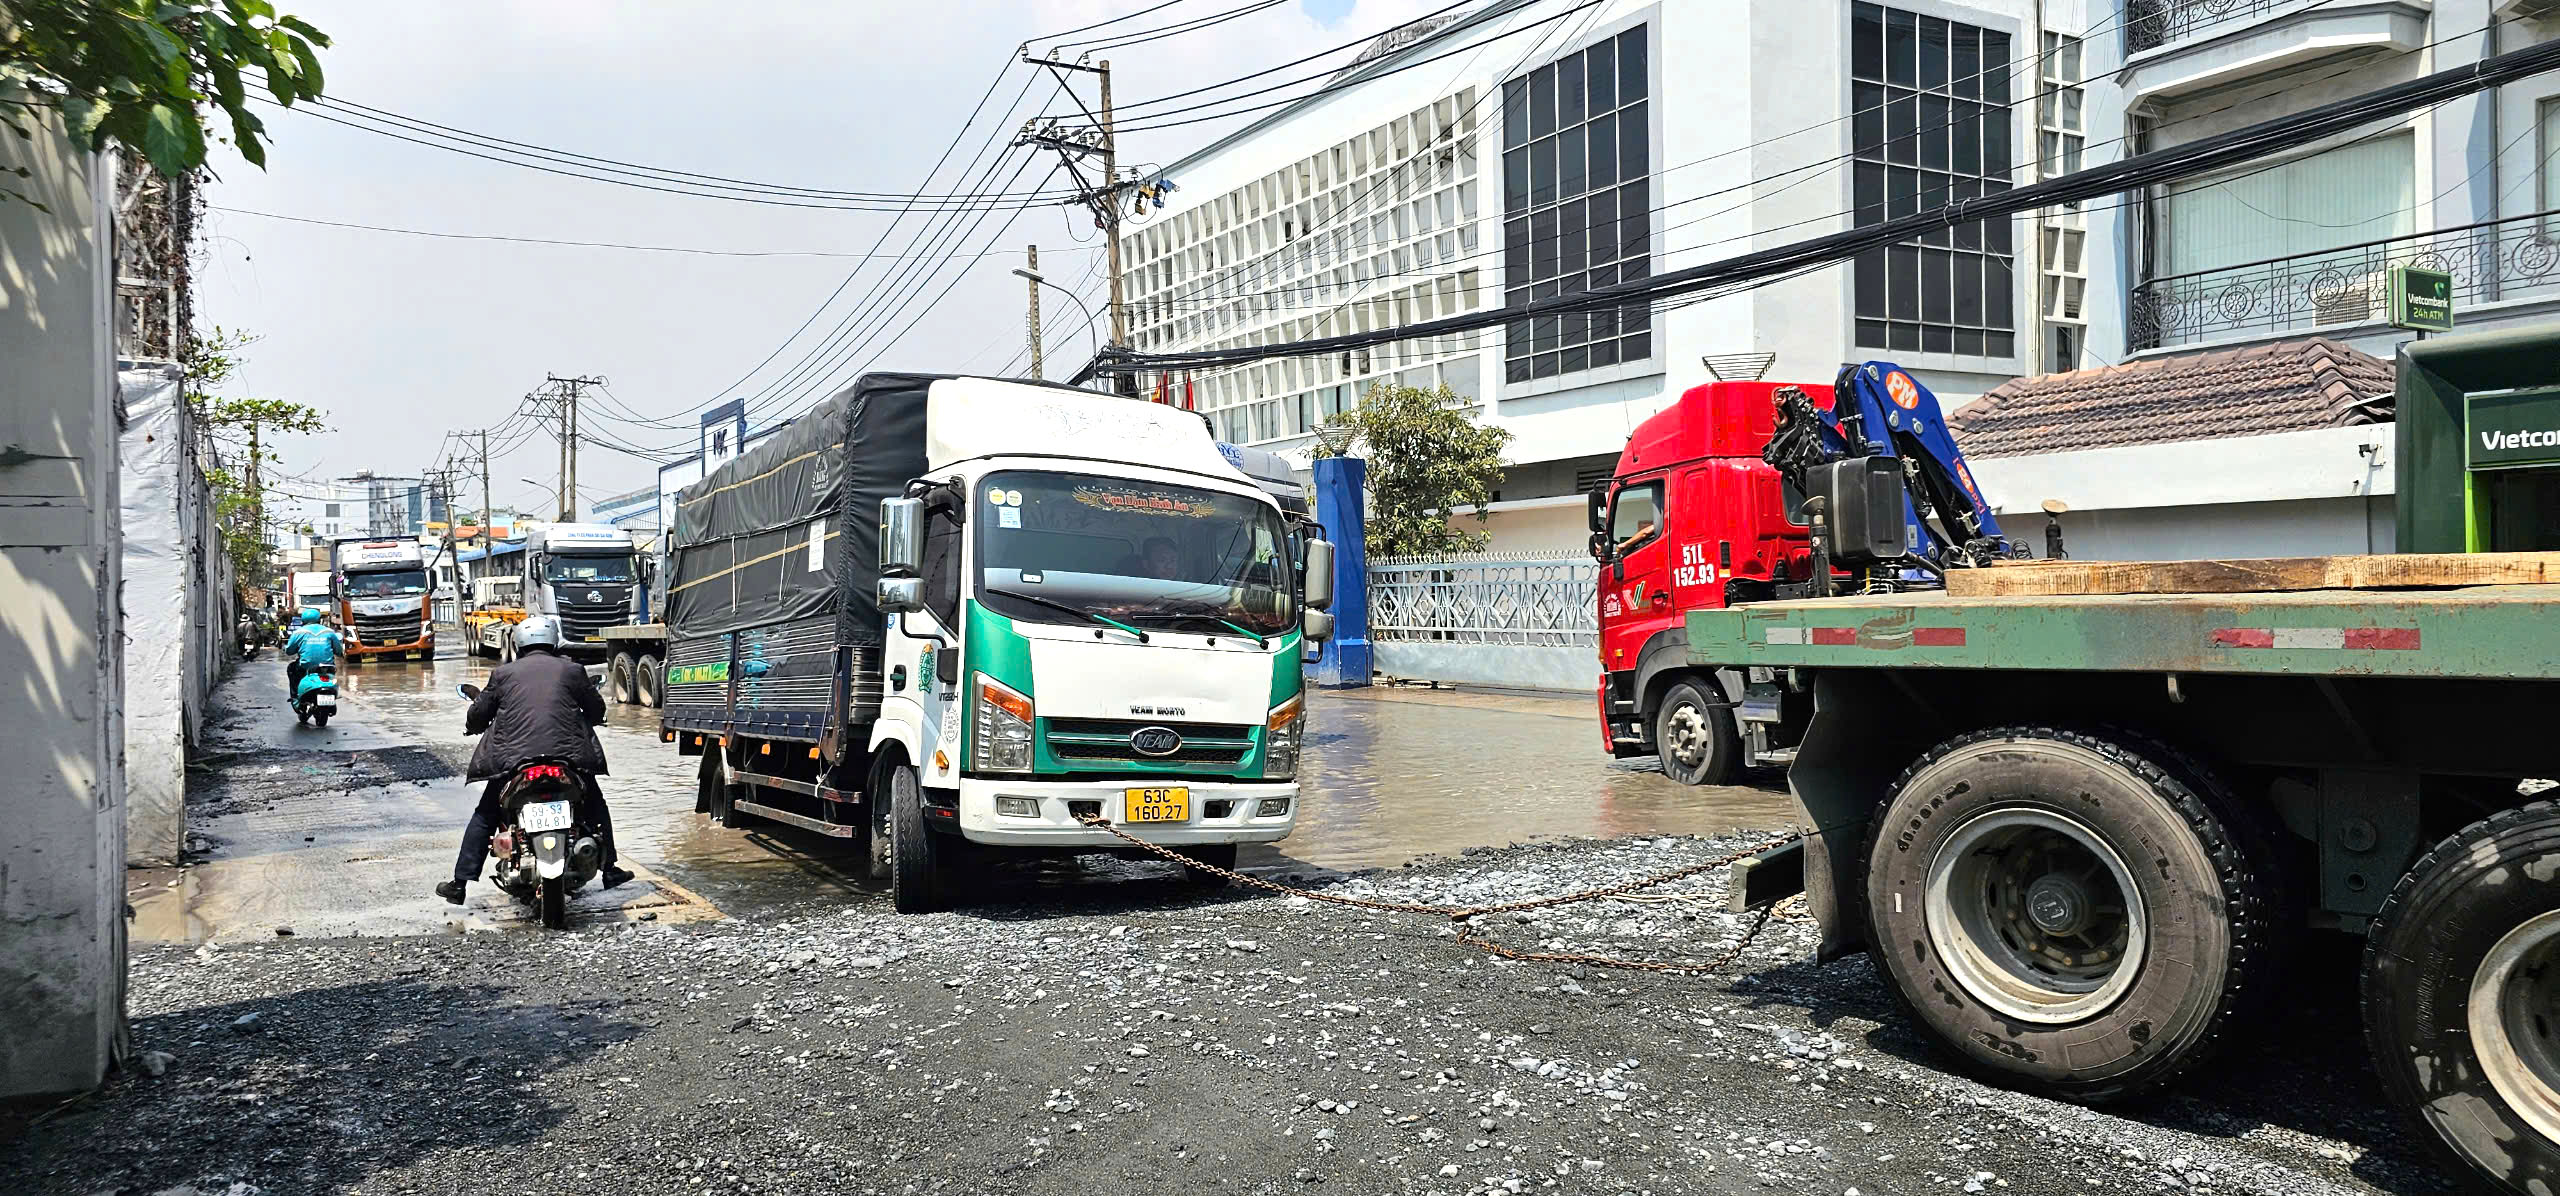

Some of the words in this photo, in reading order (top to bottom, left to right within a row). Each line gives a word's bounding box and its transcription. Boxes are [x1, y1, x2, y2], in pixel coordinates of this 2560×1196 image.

[2408, 293, 2448, 308] Vietcombank
[2413, 308, 2428, 318] 24h
[2429, 310, 2444, 320] ATM
[1888, 372, 1917, 408] PM
[1682, 544, 1705, 565] 51L
[1674, 564, 1715, 587] 152.93
[1130, 704, 1153, 715] VEAM
[1136, 733, 1178, 749] VEAM
[1143, 789, 1171, 803] 63C
[532, 804, 562, 817] 59-S3
[1135, 805, 1182, 820] 160.27
[530, 816, 566, 830] 184.81
